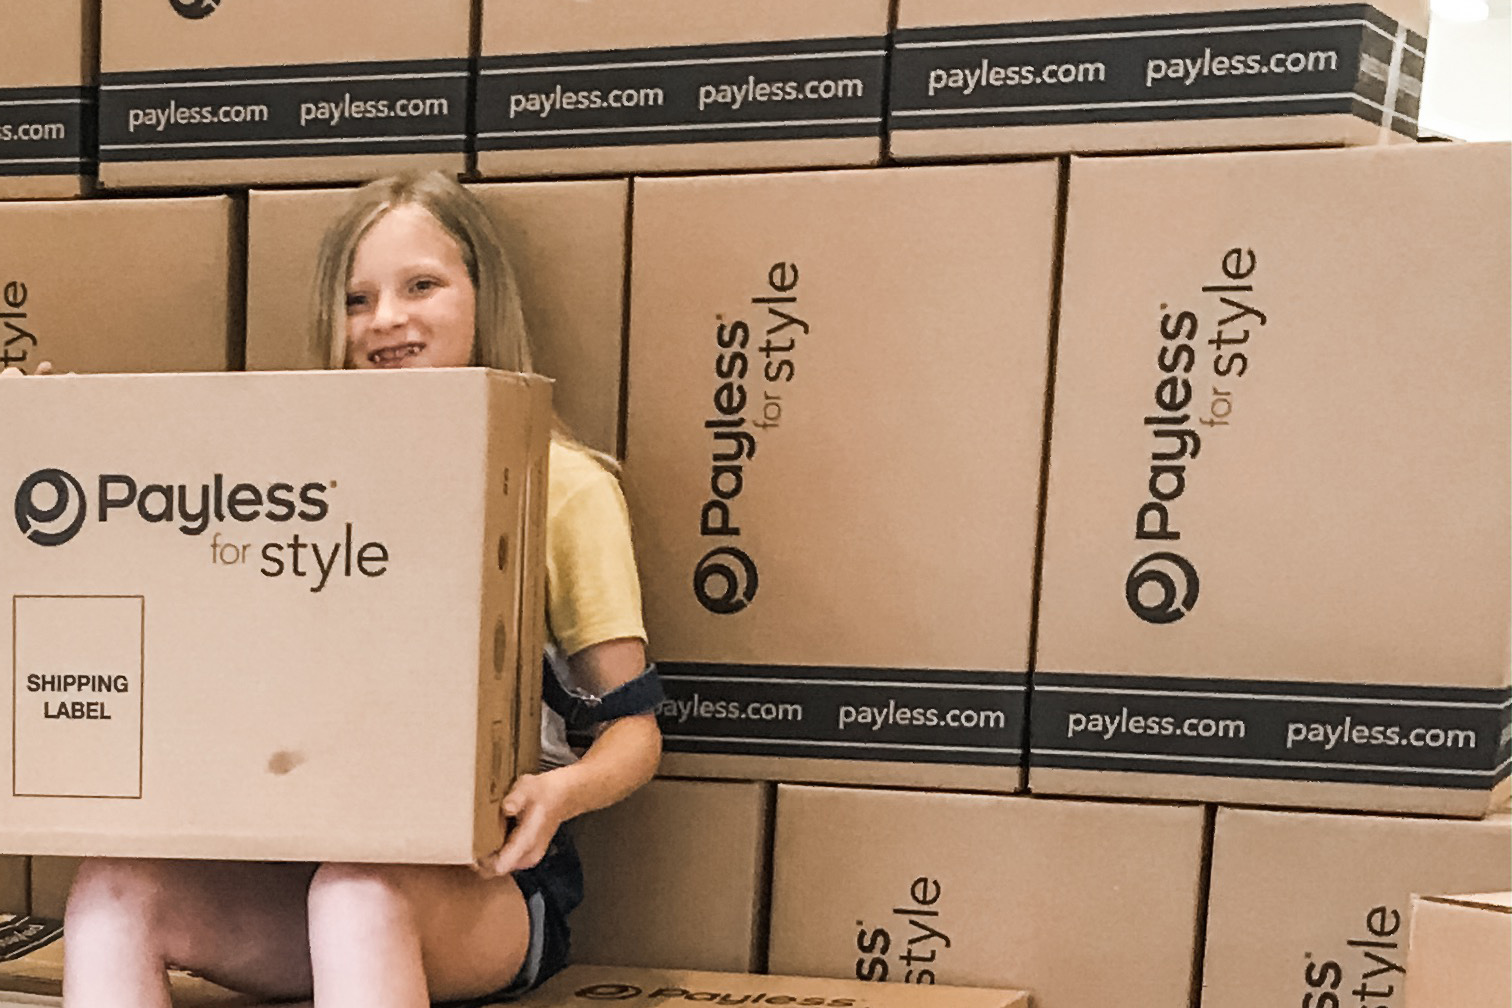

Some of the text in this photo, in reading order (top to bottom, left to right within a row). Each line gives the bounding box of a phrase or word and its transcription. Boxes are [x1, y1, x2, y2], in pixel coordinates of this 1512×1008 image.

[928, 48, 1338, 95] payless.com payless.com
[128, 93, 449, 131] payless.com payless.com
[509, 76, 863, 118] payless.com payless.com
[751, 261, 809, 430] for style
[1200, 246, 1266, 428] for style
[700, 319, 757, 536] Payless
[1135, 309, 1201, 541] Payless
[97, 473, 329, 535] Payless
[211, 522, 390, 592] for style
[26, 673, 129, 694] SHIPPING
[43, 701, 112, 721] LABEL
[839, 701, 1006, 731] payless.com
[1067, 707, 1477, 749] payless.com payless.com
[648, 987, 858, 1007] Payless
